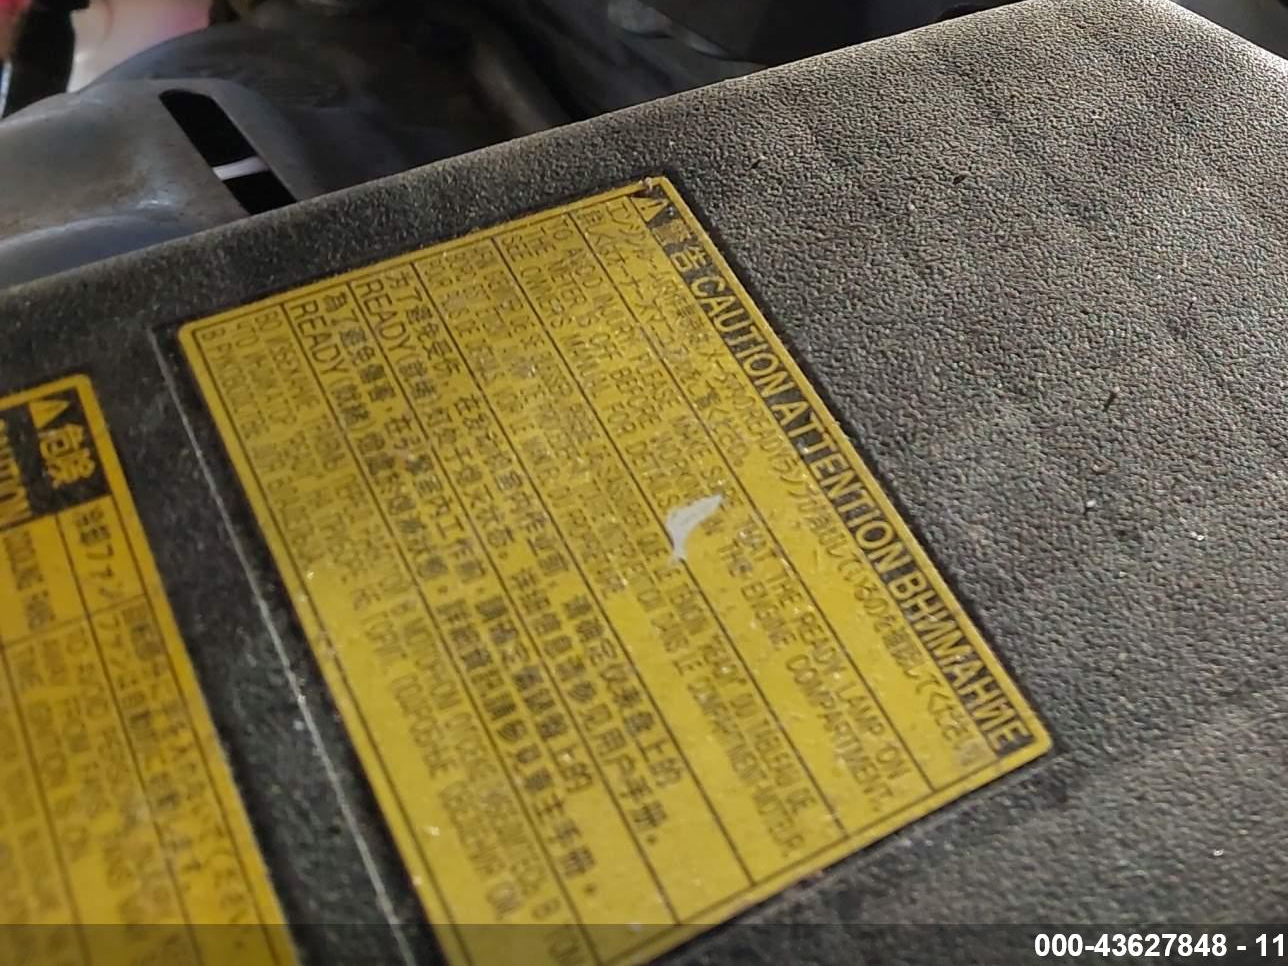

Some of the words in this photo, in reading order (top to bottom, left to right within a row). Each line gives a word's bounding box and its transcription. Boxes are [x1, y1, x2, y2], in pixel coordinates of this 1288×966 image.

[500, 233, 534, 263] SEE
[599, 401, 638, 439] FOR
[522, 226, 558, 256] THE
[607, 365, 664, 430] BEFORE
[737, 578, 800, 652] ENGINE
[546, 219, 577, 242] TO
[628, 351, 682, 411] PLEASE
[764, 569, 804, 608] THE
[788, 609, 848, 679] READY
[833, 680, 888, 743] LAMP
[871, 742, 912, 782] ON
[649, 218, 713, 274] 警告
[686, 272, 796, 399] CAUTION
[767, 394, 914, 576] ATTENTION
